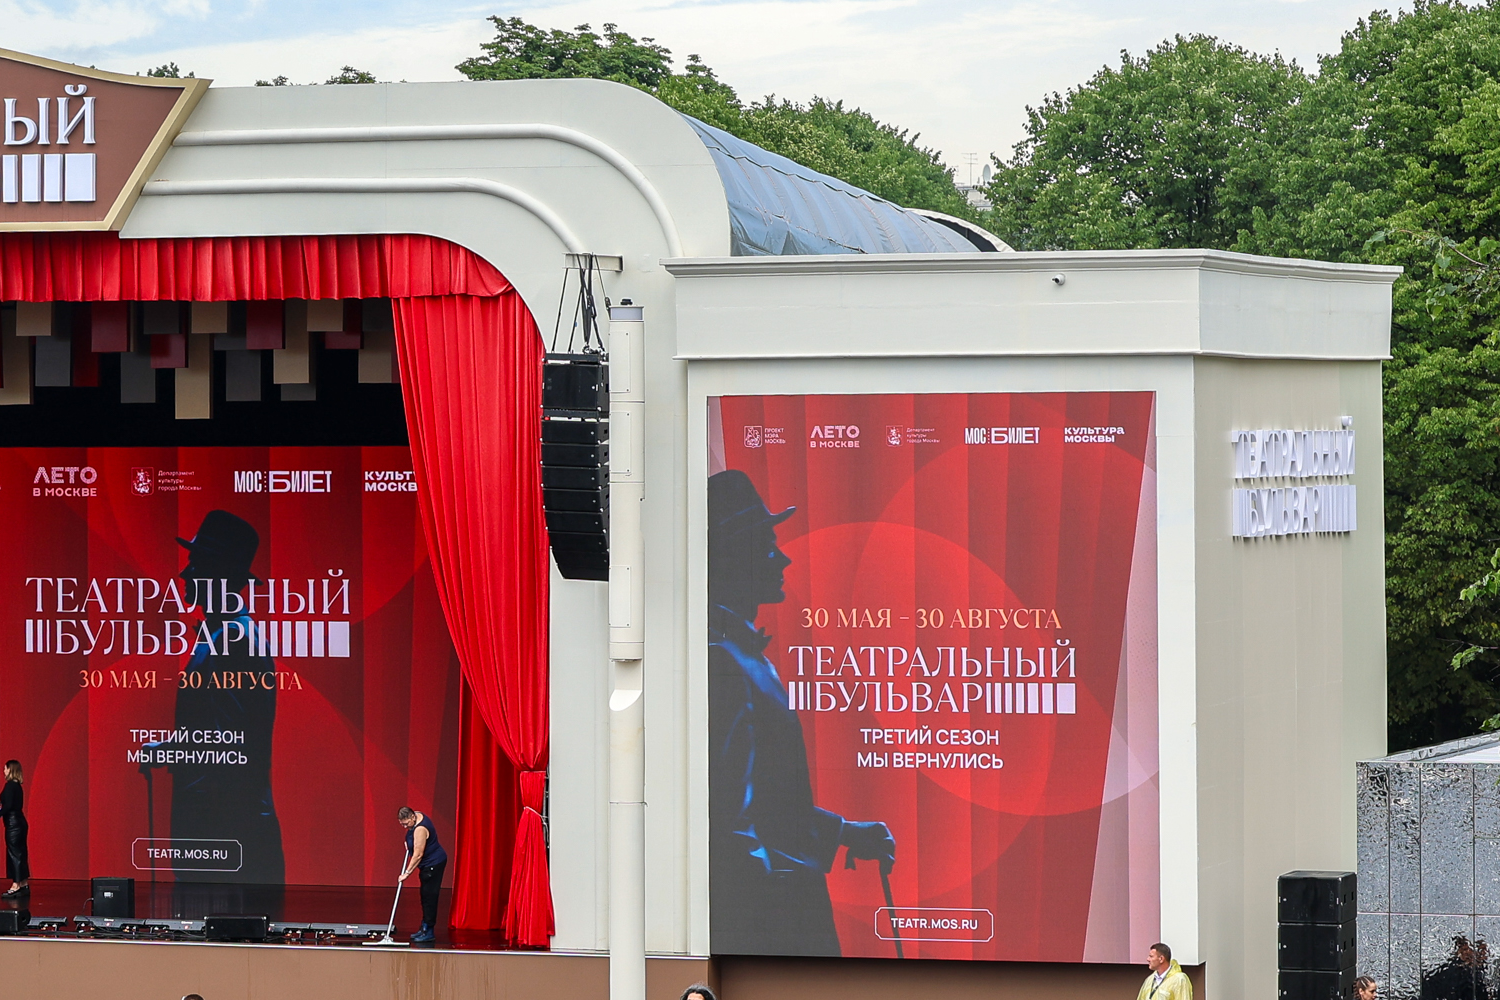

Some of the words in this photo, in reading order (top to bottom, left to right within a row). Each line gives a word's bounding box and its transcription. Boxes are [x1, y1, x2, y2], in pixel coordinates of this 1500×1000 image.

[811, 425, 860, 439] ЛЕТО
[965, 428, 987, 444] МОС
[991, 427, 1040, 444] БИЛЕТ
[1064, 435, 1115, 443] МОСКВЫ
[33, 466, 98, 484] ЛЕТО
[234, 471, 263, 493] МОС
[268, 471, 332, 493] БИЛЕТ
[33, 488, 42, 497] В
[45, 488, 98, 497] МОСКВЕ
[25, 569, 350, 614] ТЕАТРАЛЬНЫЙ
[801, 608, 829, 629] 30
[836, 608, 893, 629] МАЯ
[916, 608, 944, 629] 30
[950, 608, 1063, 630] АВГУСТА
[54, 619, 246, 656] БУЛЬВАР
[788, 639, 1077, 678] ТЕАТРАЛЬНЫЙ
[78, 669, 103, 690] 30
[109, 669, 158, 690] МАЯ
[177, 669, 202, 690] 30
[207, 669, 303, 692] АВГУСТА
[814, 681, 984, 714] БУЛЬВАР
[130, 726, 189, 744] ТРЕТИЙ
[192, 729, 245, 745] СЕЗОН
[860, 725, 931, 745] ТРЕТИЙ
[936, 729, 1000, 746] СЕЗОН
[127, 749, 153, 764] МЫ
[156, 750, 248, 765] ВЕРНУЛИСЬ
[857, 751, 888, 768] МЫ
[892, 751, 1003, 769] ВЕРНУЛИСЬ
[146, 847, 228, 860] TEATR.MOS.RU
[891, 916, 978, 930] TEATR.MOS.RU
